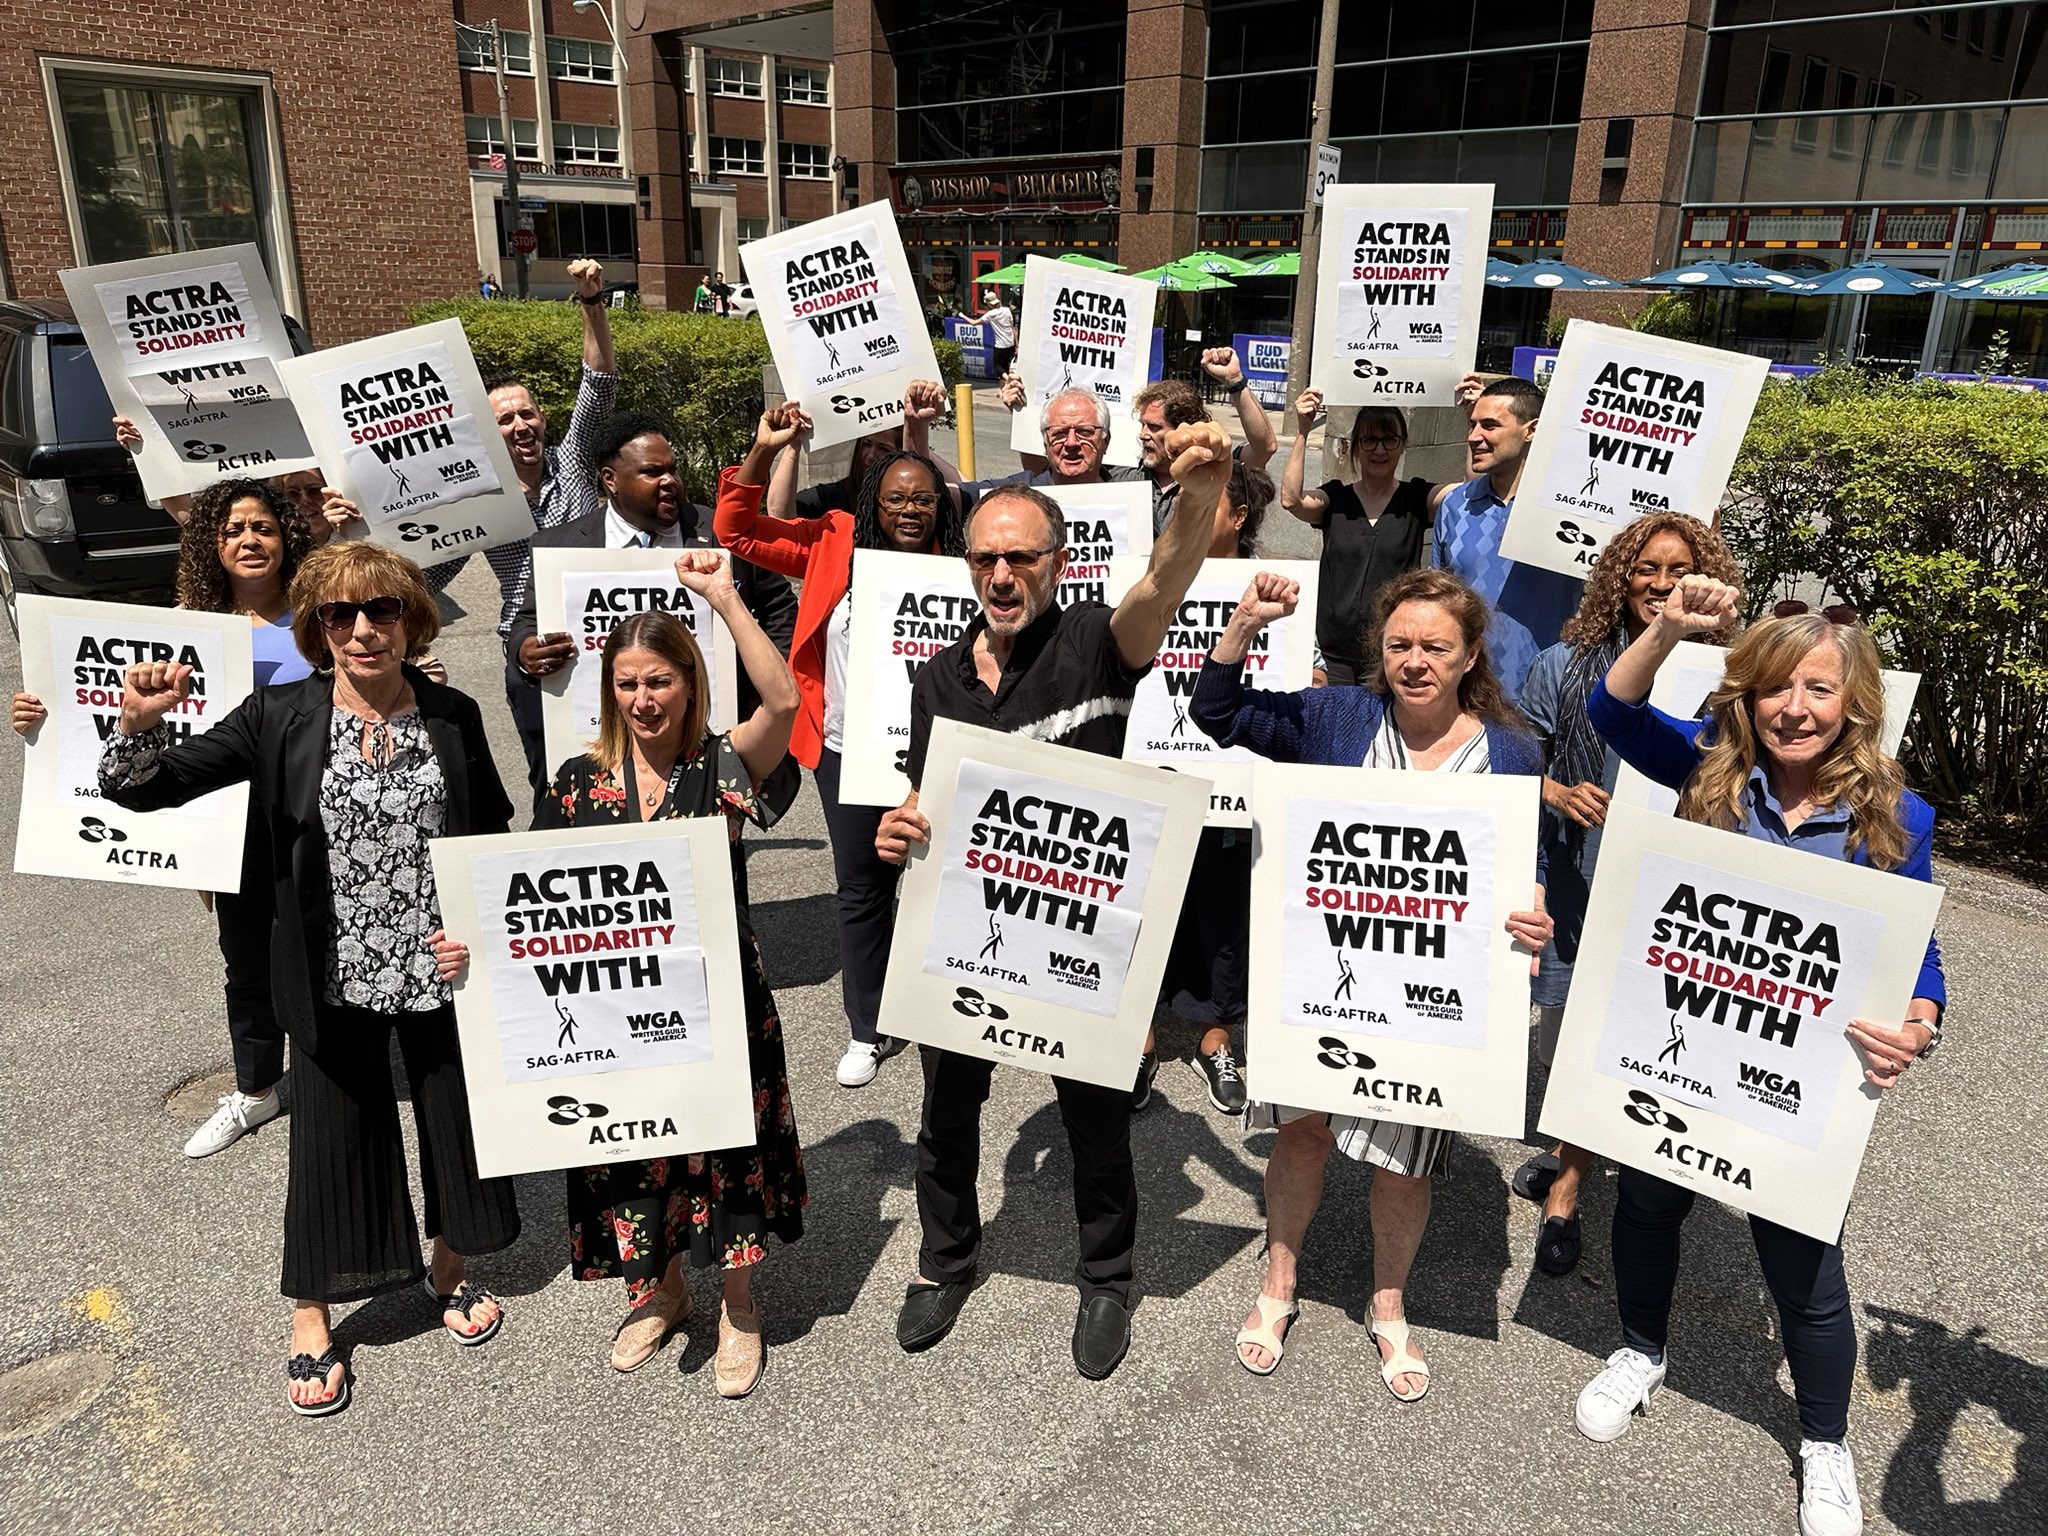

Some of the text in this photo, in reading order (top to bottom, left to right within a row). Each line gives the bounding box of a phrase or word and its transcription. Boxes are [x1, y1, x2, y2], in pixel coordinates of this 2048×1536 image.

[512, 235, 537, 247] STOP
[1357, 222, 1451, 246] ACTRA
[786, 240, 870, 284] ACTRA
[1354, 248, 1450, 265] STANDS IN
[787, 262, 876, 302] STANDS IN
[1352, 266, 1450, 281] SOLIDARITY
[126, 281, 234, 320] ACTRA
[792, 279, 879, 317] SOLIDARITY
[1055, 287, 1127, 319] ACTRA
[1363, 284, 1436, 306] WITH
[128, 306, 242, 339] STANDS IN
[808, 300, 879, 339] WITH
[960, 326, 978, 336] BUD
[1052, 308, 1127, 334] STANDS IN
[1409, 322, 1443, 334] WGA
[136, 324, 246, 355] SOLIDARITY
[864, 334, 897, 352] WGA
[1051, 325, 1126, 348] SOLIDARITY
[1255, 344, 1282, 357] BUD
[1059, 342, 1115, 370] WITH
[1250, 356, 1287, 370] LIGHT
[157, 361, 246, 385] WITH
[340, 362, 442, 408] ACTRA
[1594, 361, 1705, 408] ACTRA
[228, 384, 268, 399] WGA
[1094, 382, 1121, 395] WGA
[1373, 381, 1426, 394] ACTRA
[343, 385, 450, 428] STANDS IN
[858, 399, 905, 423] ACTRA
[1586, 388, 1703, 429] STANDS IN
[351, 403, 454, 445] SOLIDARITY
[1581, 408, 1697, 447] SOLIDARITY
[369, 424, 454, 465] WITH
[1588, 432, 1674, 475] WITH
[217, 449, 276, 472] ACTRA
[437, 458, 477, 478] WGA
[1632, 488, 1669, 510] WGA
[431, 525, 487, 551] ACTRA
[1094, 545, 1114, 562] IN
[584, 588, 695, 612] ACTRA
[896, 592, 978, 622] ACTR
[1060, 582, 1105, 605] ITH
[893, 619, 965, 642] STAND
[75, 636, 205, 673] ACTRA
[74, 665, 126, 688] STA
[667, 765, 685, 794] ACTRA
[1210, 795, 1247, 812] TRA
[977, 788, 1130, 853] ACTRA
[969, 823, 1128, 880] STANDS IN
[1310, 821, 1468, 866] ACTRA
[106, 848, 179, 870] ACTRA
[505, 860, 669, 907] ACTRA
[964, 849, 1124, 903] SOLIDARITY
[1306, 858, 1468, 897] STANDS IN
[504, 897, 673, 935] STANDS IN
[982, 877, 1100, 936] WITH
[1305, 886, 1470, 923] SOLIDARITY
[1323, 912, 1446, 960] WITH
[1661, 882, 1841, 964] ACTRA
[508, 924, 676, 959] SOLIDARITY
[1651, 917, 1840, 994] STANDS IN
[533, 955, 662, 997] WITH
[1047, 968, 1100, 986] WRITERS GUILD
[1048, 951, 1101, 980] WGA
[1065, 978, 1099, 992] AMERICA
[1404, 983, 1463, 1007] WGA
[1645, 946, 1834, 1018] SOLIDARITY
[626, 1010, 685, 1031] WGA
[1405, 1002, 1463, 1015] WRITERS GUILD
[1427, 1011, 1463, 1022] AMERICA
[1664, 972, 1802, 1048] WITH
[630, 1027, 687, 1039] WRITERS GUILD
[652, 1033, 687, 1043] AMERICA
[981, 1024, 1066, 1060] ACTRA
[1352, 1077, 1444, 1108] ACTRA
[1737, 1081, 1800, 1109] WRITERS GUILD
[1739, 1061, 1802, 1102] WGA
[1758, 1096, 1798, 1116] AMERICA
[588, 1117, 679, 1145] ACTRA
[1654, 1137, 1753, 1191] ACTRA
